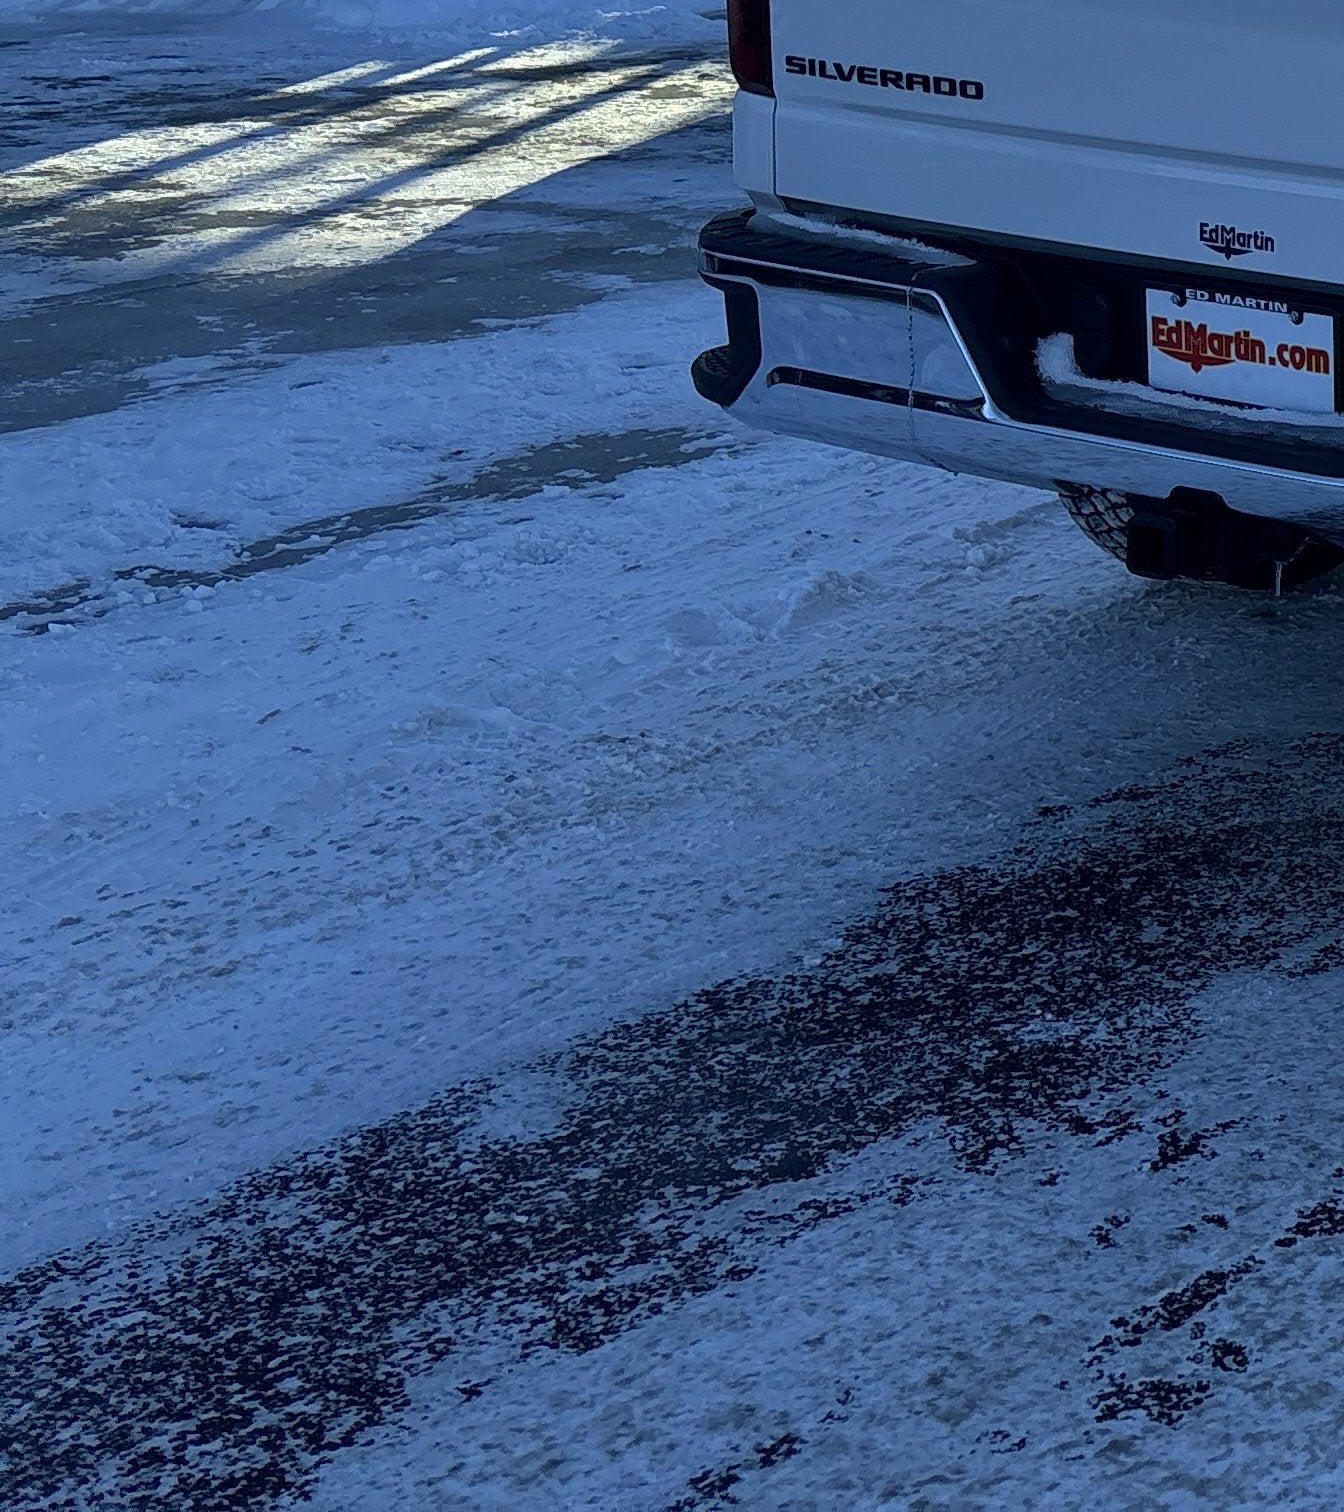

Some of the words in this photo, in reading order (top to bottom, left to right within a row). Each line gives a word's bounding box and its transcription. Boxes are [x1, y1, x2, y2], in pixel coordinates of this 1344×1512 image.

[785, 55, 984, 100] SILVERADO
[1186, 289, 1209, 301] ED
[1215, 294, 1288, 313] MARTIN
[1152, 315, 1330, 375] EdMartin.com
